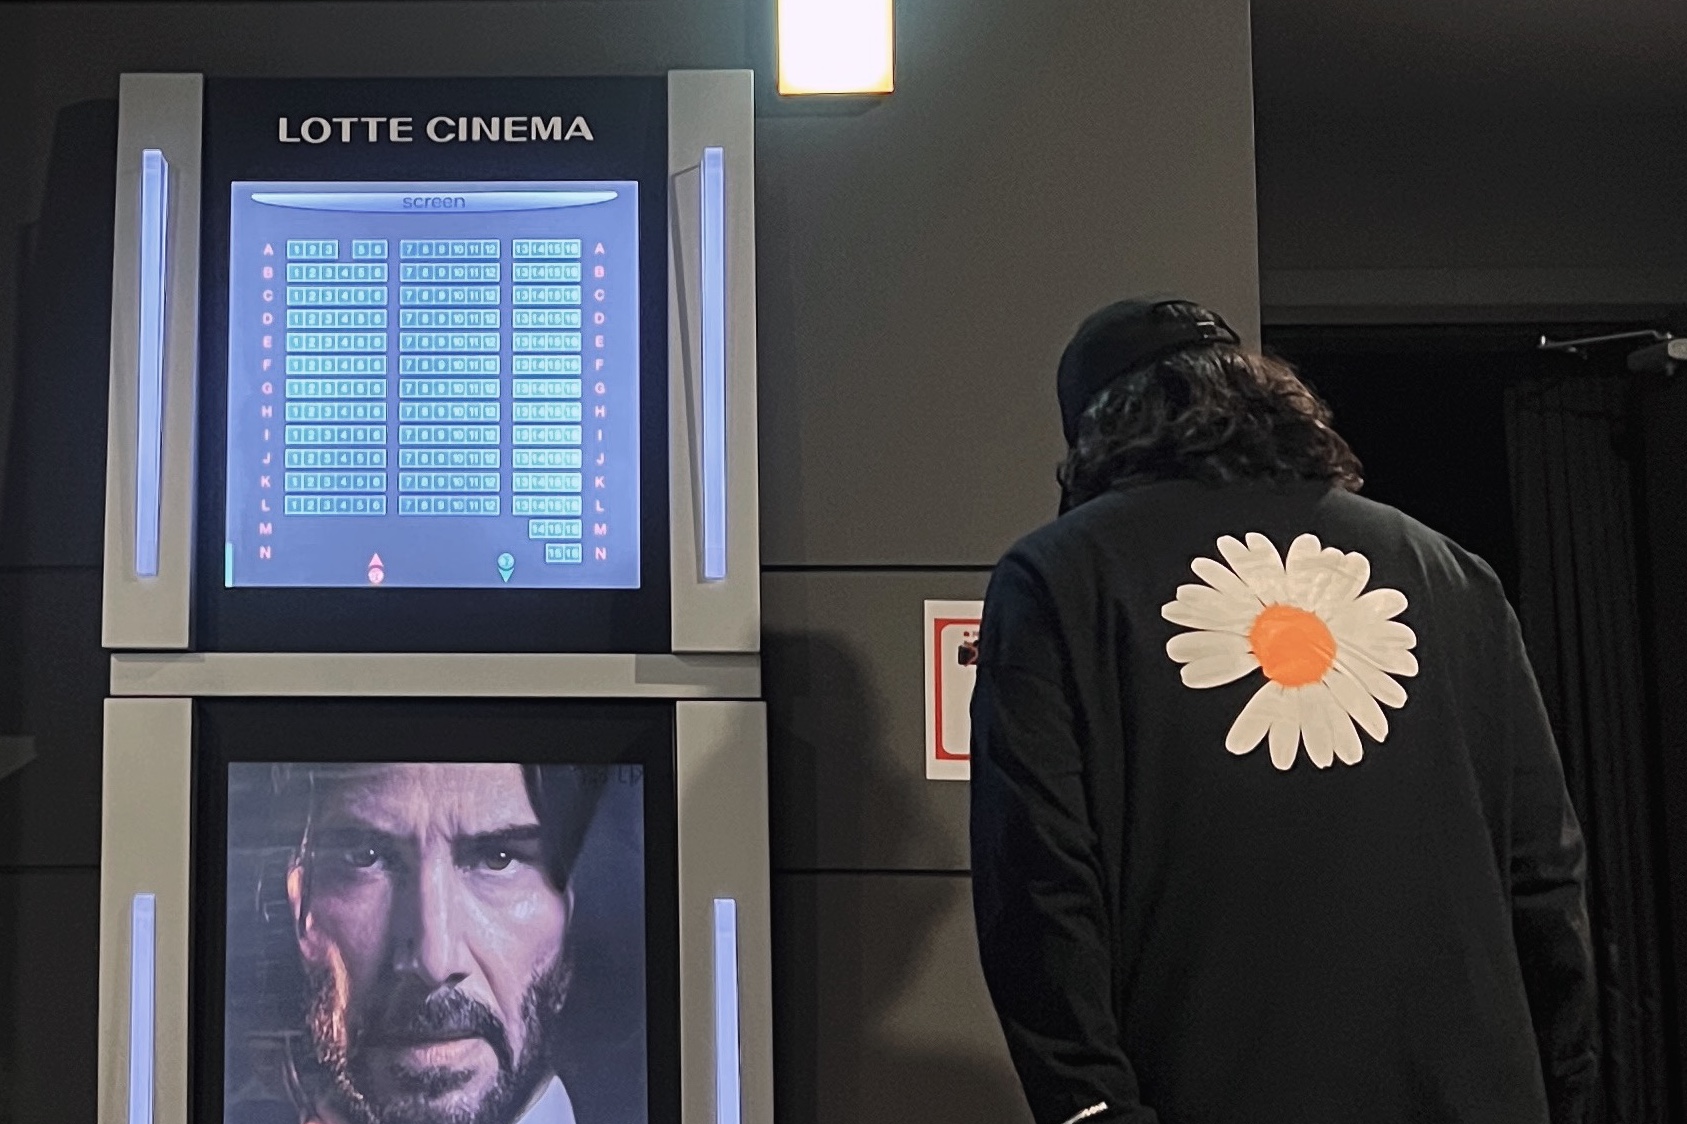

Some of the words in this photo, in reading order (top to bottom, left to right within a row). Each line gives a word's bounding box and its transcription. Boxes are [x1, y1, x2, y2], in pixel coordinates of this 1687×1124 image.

[277, 116, 413, 144] LOTTE
[426, 115, 594, 143] CINEMA
[402, 195, 466, 209] screen
[264, 244, 273, 255] A
[469, 244, 479, 255] 11
[595, 243, 604, 254] A
[263, 267, 273, 278] B
[469, 267, 479, 278] 11
[595, 266, 604, 277] B
[263, 290, 273, 302] C
[469, 291, 479, 302] 11
[594, 289, 604, 301] C
[263, 313, 273, 325] D
[469, 314, 479, 325] 11
[594, 312, 604, 324] D
[263, 336, 271, 348] E
[469, 337, 479, 348] 11
[595, 335, 603, 347] E
[263, 359, 271, 370] F
[469, 361, 479, 371] 11
[596, 359, 603, 370] F
[262, 382, 272, 394] G
[469, 384, 479, 395] 11
[595, 382, 605, 394] G
[262, 406, 272, 417] H
[469, 407, 479, 418] 11
[595, 406, 605, 417] H
[265, 429, 269, 440] I
[469, 430, 479, 441] 11
[598, 430, 602, 440] I
[263, 453, 270, 464] J
[469, 454, 479, 465] 11
[597, 453, 604, 465] J
[261, 476, 270, 487] K
[469, 477, 479, 488] 11
[595, 477, 604, 487] K
[261, 500, 270, 511] L
[469, 500, 479, 511] 11
[596, 500, 604, 512] L
[260, 523, 272, 534] M
[594, 524, 607, 535] M
[260, 547, 271, 558] N
[596, 547, 606, 559] N
